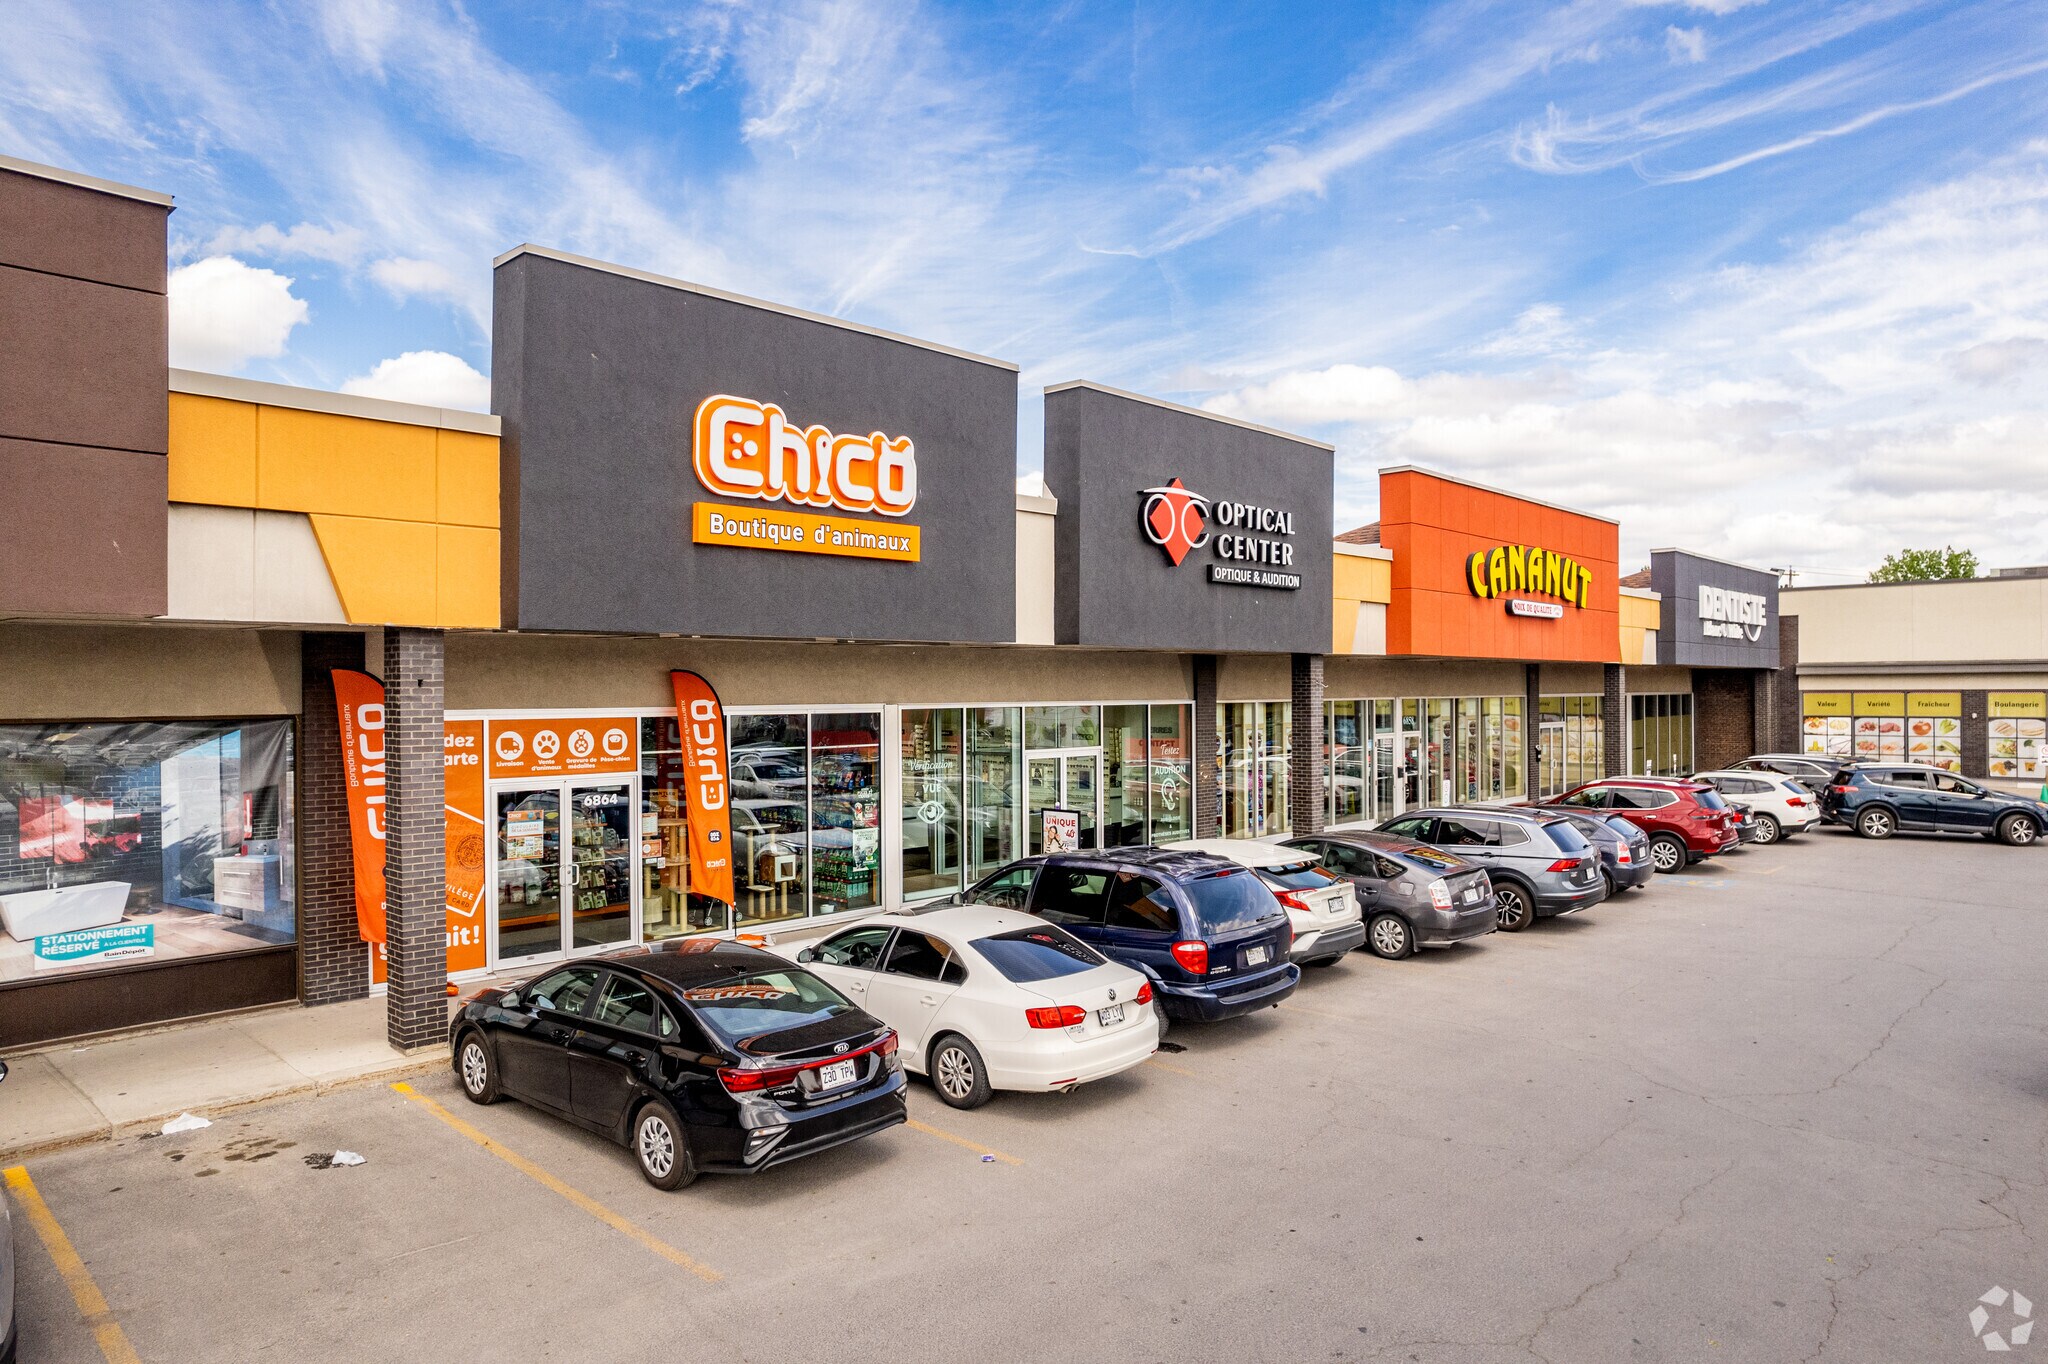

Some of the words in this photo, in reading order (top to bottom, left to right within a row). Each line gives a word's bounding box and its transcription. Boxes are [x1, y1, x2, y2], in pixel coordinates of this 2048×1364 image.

[710, 405, 914, 506] Chico
[1217, 500, 1296, 535] OPTICAL
[709, 512, 805, 544] Boutique
[814, 525, 912, 553] d'animaux
[1218, 533, 1294, 566] CENTER
[1214, 566, 1252, 583] OPTIQUE
[1253, 570, 1261, 584] &
[1261, 573, 1301, 588] AUDITION
[1471, 544, 1593, 609] CANANUT
[1527, 604, 1533, 612] DE
[1698, 585, 1767, 627] DENTISTE
[1994, 701, 2040, 709] Boulangerie
[1160, 744, 1180, 755] Testez
[600, 755, 631, 763] Pèse-chien
[531, 764, 562, 772] d'animaux
[922, 783, 942, 793] VUE
[584, 793, 619, 807] 6864
[1046, 817, 1076, 827] UNIQUE
[451, 897, 470, 908] CARD
[41, 926, 148, 946] STATIONNEMENT
[41, 941, 100, 956] RÉSERVÉ
[836, 1044, 849, 1052] KIA
[822, 1069, 837, 1084] Z30
[840, 1067, 855, 1079] TPW
